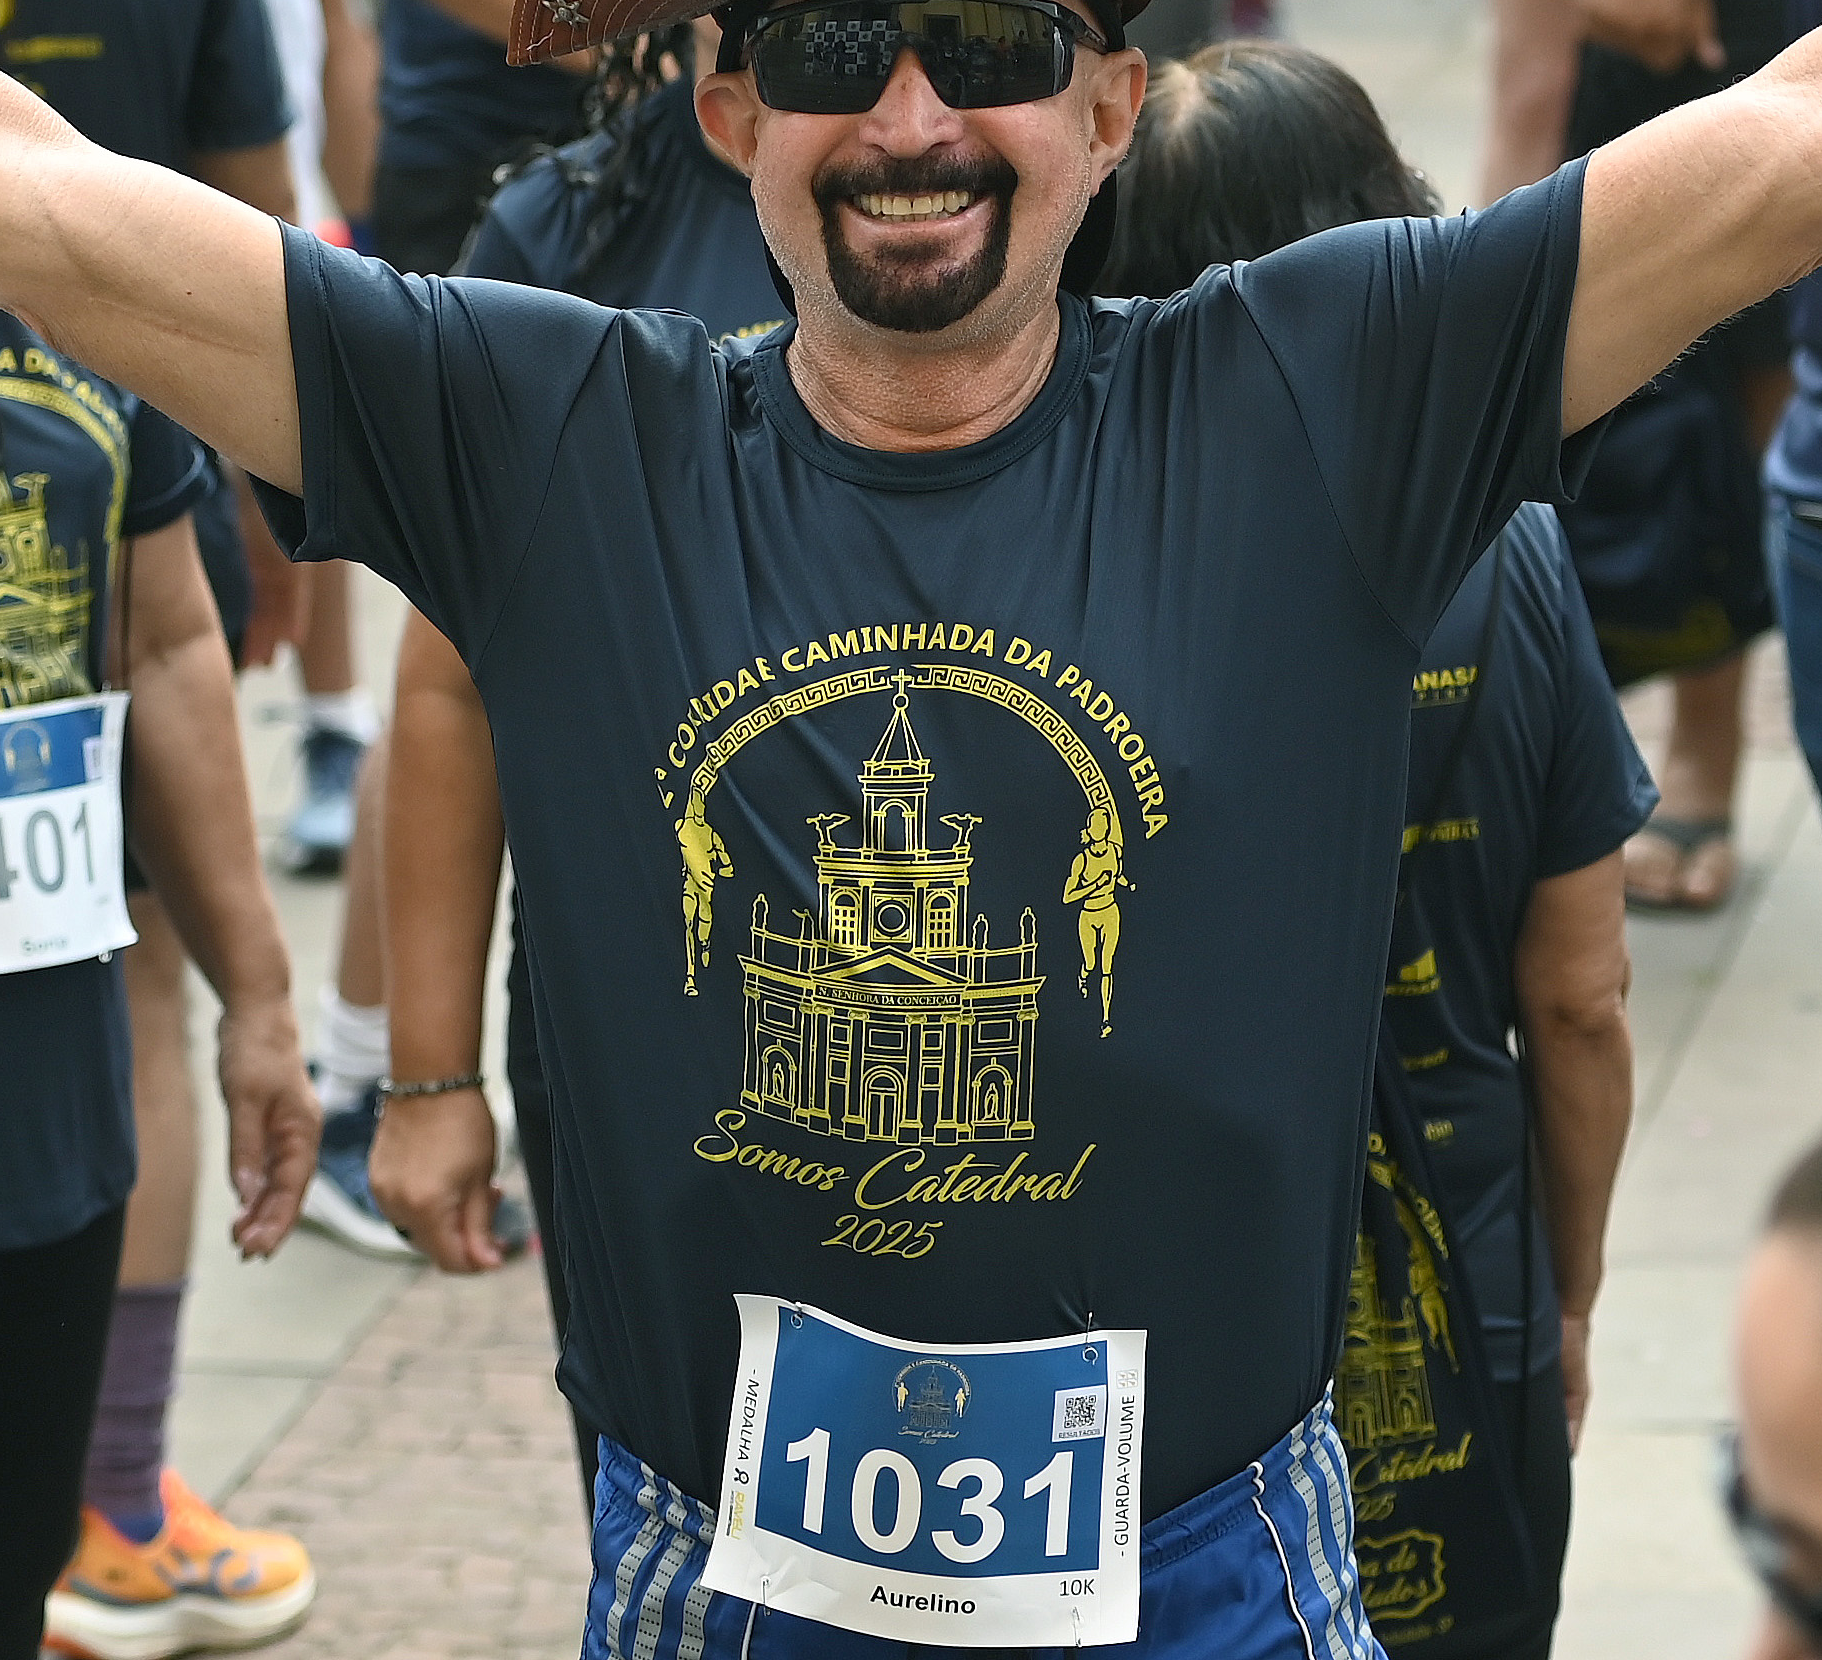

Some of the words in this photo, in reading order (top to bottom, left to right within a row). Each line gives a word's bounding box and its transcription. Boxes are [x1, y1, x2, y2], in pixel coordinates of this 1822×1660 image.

[781, 622, 996, 672] CAMINHADA
[1003, 636, 1053, 678] DA
[1055, 664, 1170, 840] PADROEIRA
[831, 989, 880, 1005] SENHORA
[881, 995, 895, 1006] DA
[692, 1107, 852, 1192] Somos
[854, 1142, 1097, 1211] Catedral
[820, 1213, 945, 1259] 2025
[737, 1378, 760, 1461] MEDALHA
[785, 1426, 1075, 1565] 1031
[1114, 1394, 1136, 1546] GUARDA-VOLUME
[869, 1584, 977, 1616] Aurelino
[1058, 1577, 1096, 1598] 10K
